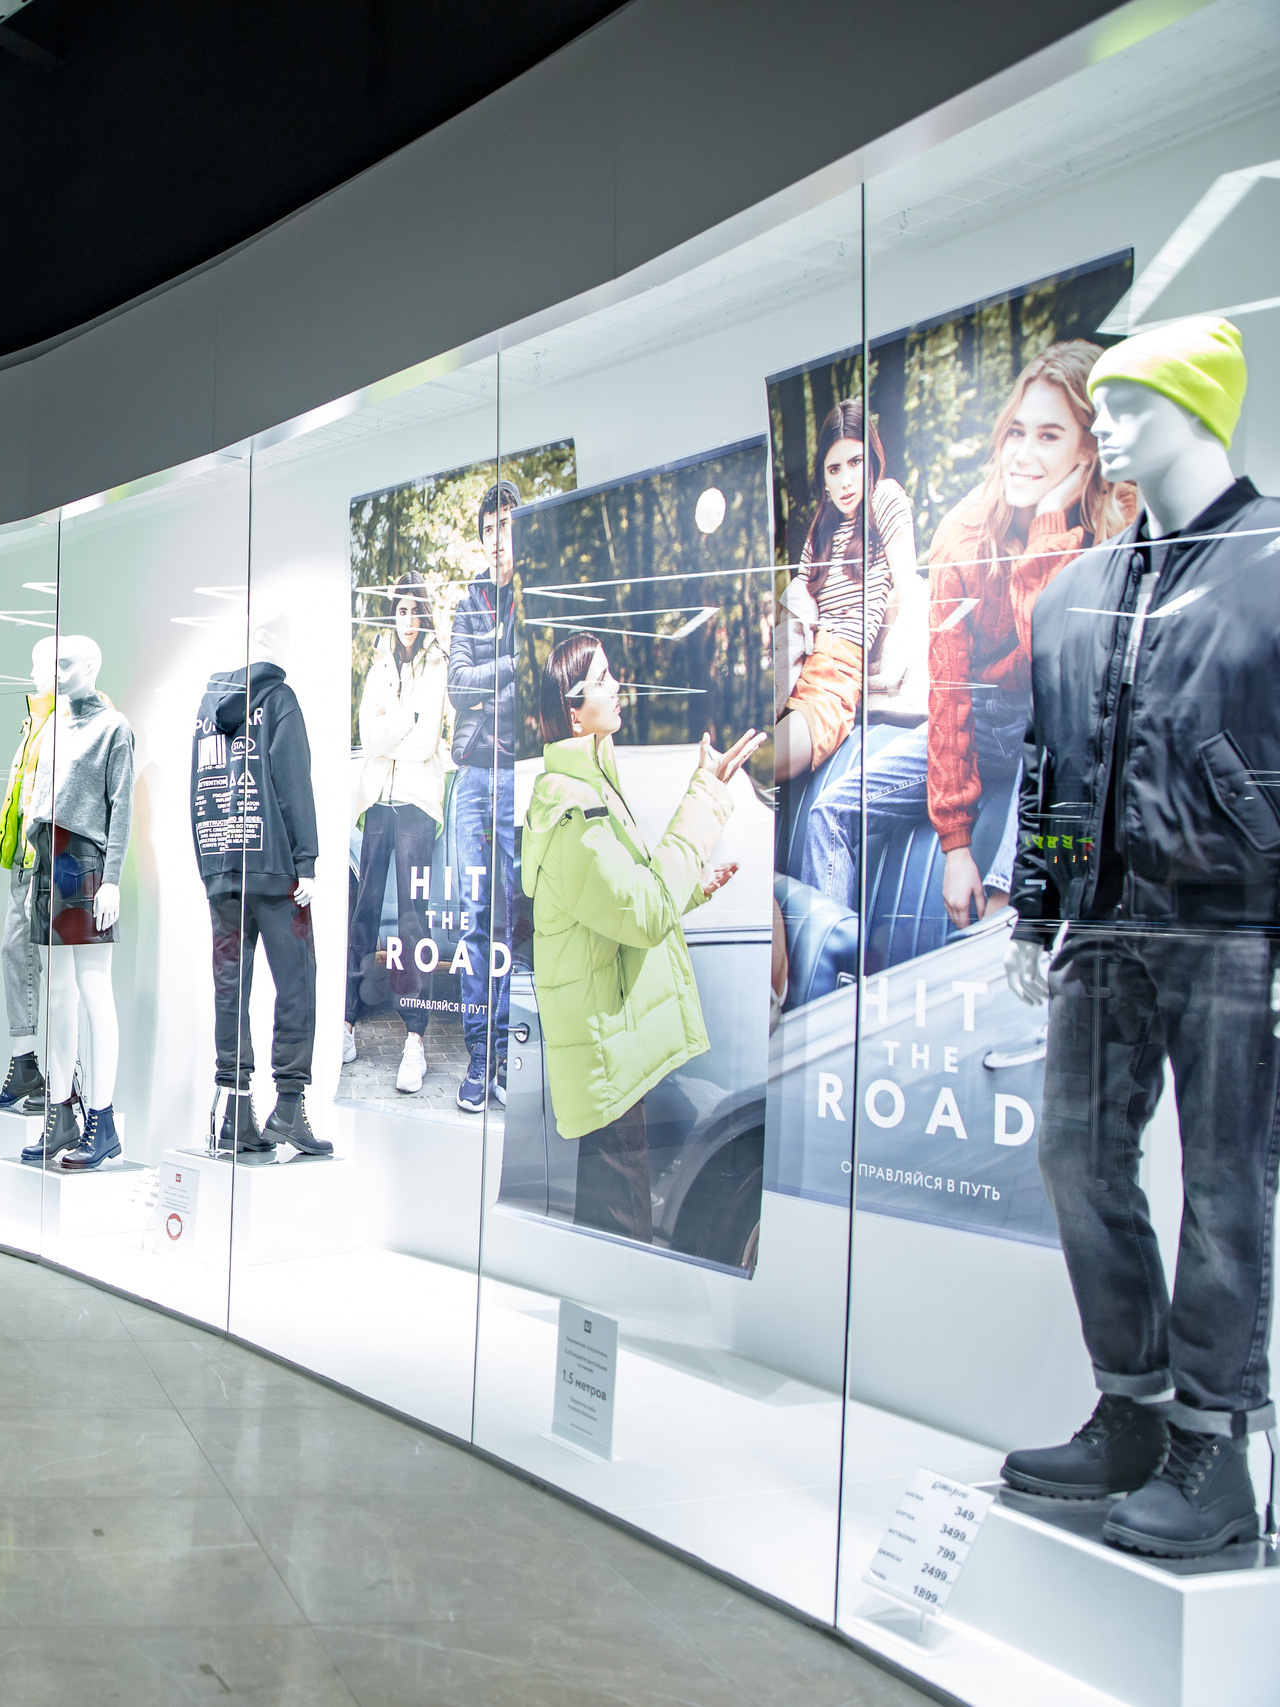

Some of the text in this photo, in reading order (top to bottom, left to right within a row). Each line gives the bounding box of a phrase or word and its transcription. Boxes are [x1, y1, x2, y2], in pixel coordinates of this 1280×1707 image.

[410, 866, 487, 901] HIT
[425, 910, 470, 930] THE
[386, 936, 512, 978] ROAD
[400, 997, 489, 1015] ОТПРАВЛЯЙСЯ В ПУТ
[861, 975, 988, 1032] HIT
[882, 1040, 959, 1073] THE
[817, 1071, 1035, 1147] ROAD
[840, 1160, 1001, 1201] ОПРАВЛЯЙСЯ В ПУТЬ
[562, 1369, 607, 1401] 1.5 метров
[954, 1506, 975, 1522] 349
[939, 1523, 967, 1543] 3499
[936, 1545, 957, 1562] 799
[921, 1562, 948, 1582] 2499
[913, 1584, 938, 1604] 1899
